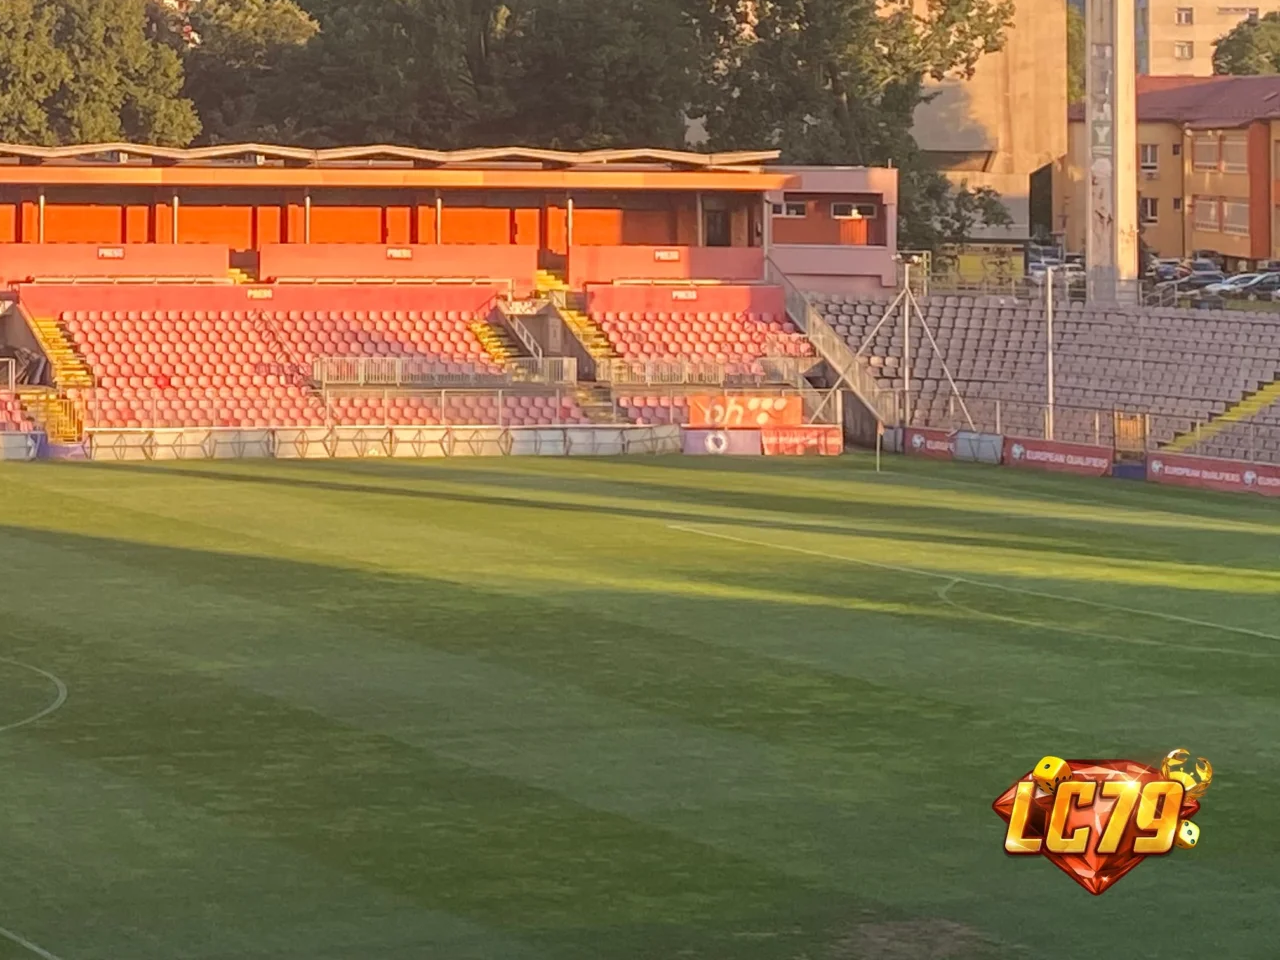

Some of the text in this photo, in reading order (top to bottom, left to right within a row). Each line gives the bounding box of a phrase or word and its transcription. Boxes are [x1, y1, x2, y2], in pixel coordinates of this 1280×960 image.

[98, 247, 124, 258] PRESS
[387, 248, 412, 259] PRESS
[655, 250, 680, 261] PRESS
[247, 289, 273, 299] PRESS
[672, 290, 697, 300] PRESS
[1026, 450, 1108, 468] EUROPEAN QUALIFIERS
[1164, 465, 1240, 482] EUROPEAN QUALIFIERS
